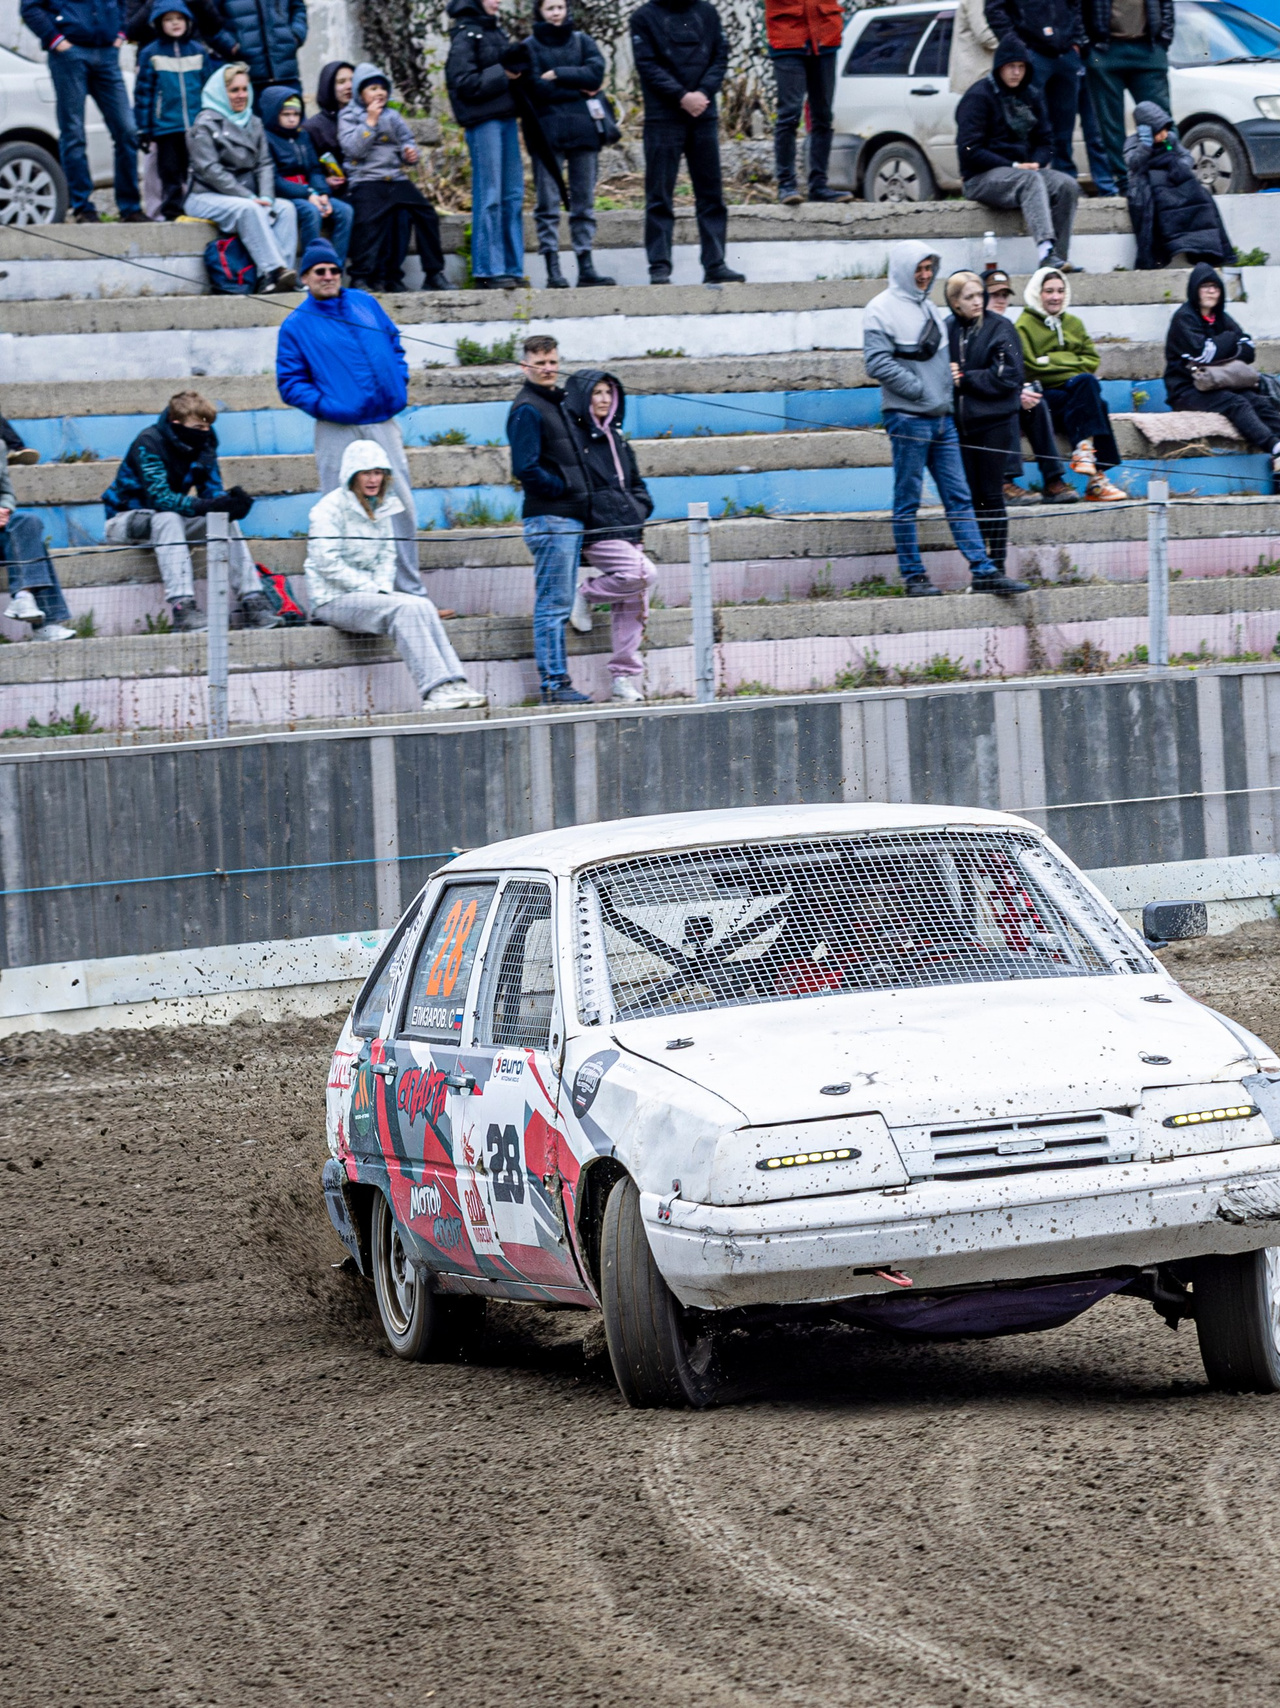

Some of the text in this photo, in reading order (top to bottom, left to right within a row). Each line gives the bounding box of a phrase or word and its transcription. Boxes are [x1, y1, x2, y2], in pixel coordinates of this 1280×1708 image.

[426, 899, 477, 997] 28
[410, 1183, 442, 1220] МОТОР
[487, 1123, 525, 1205] 28
